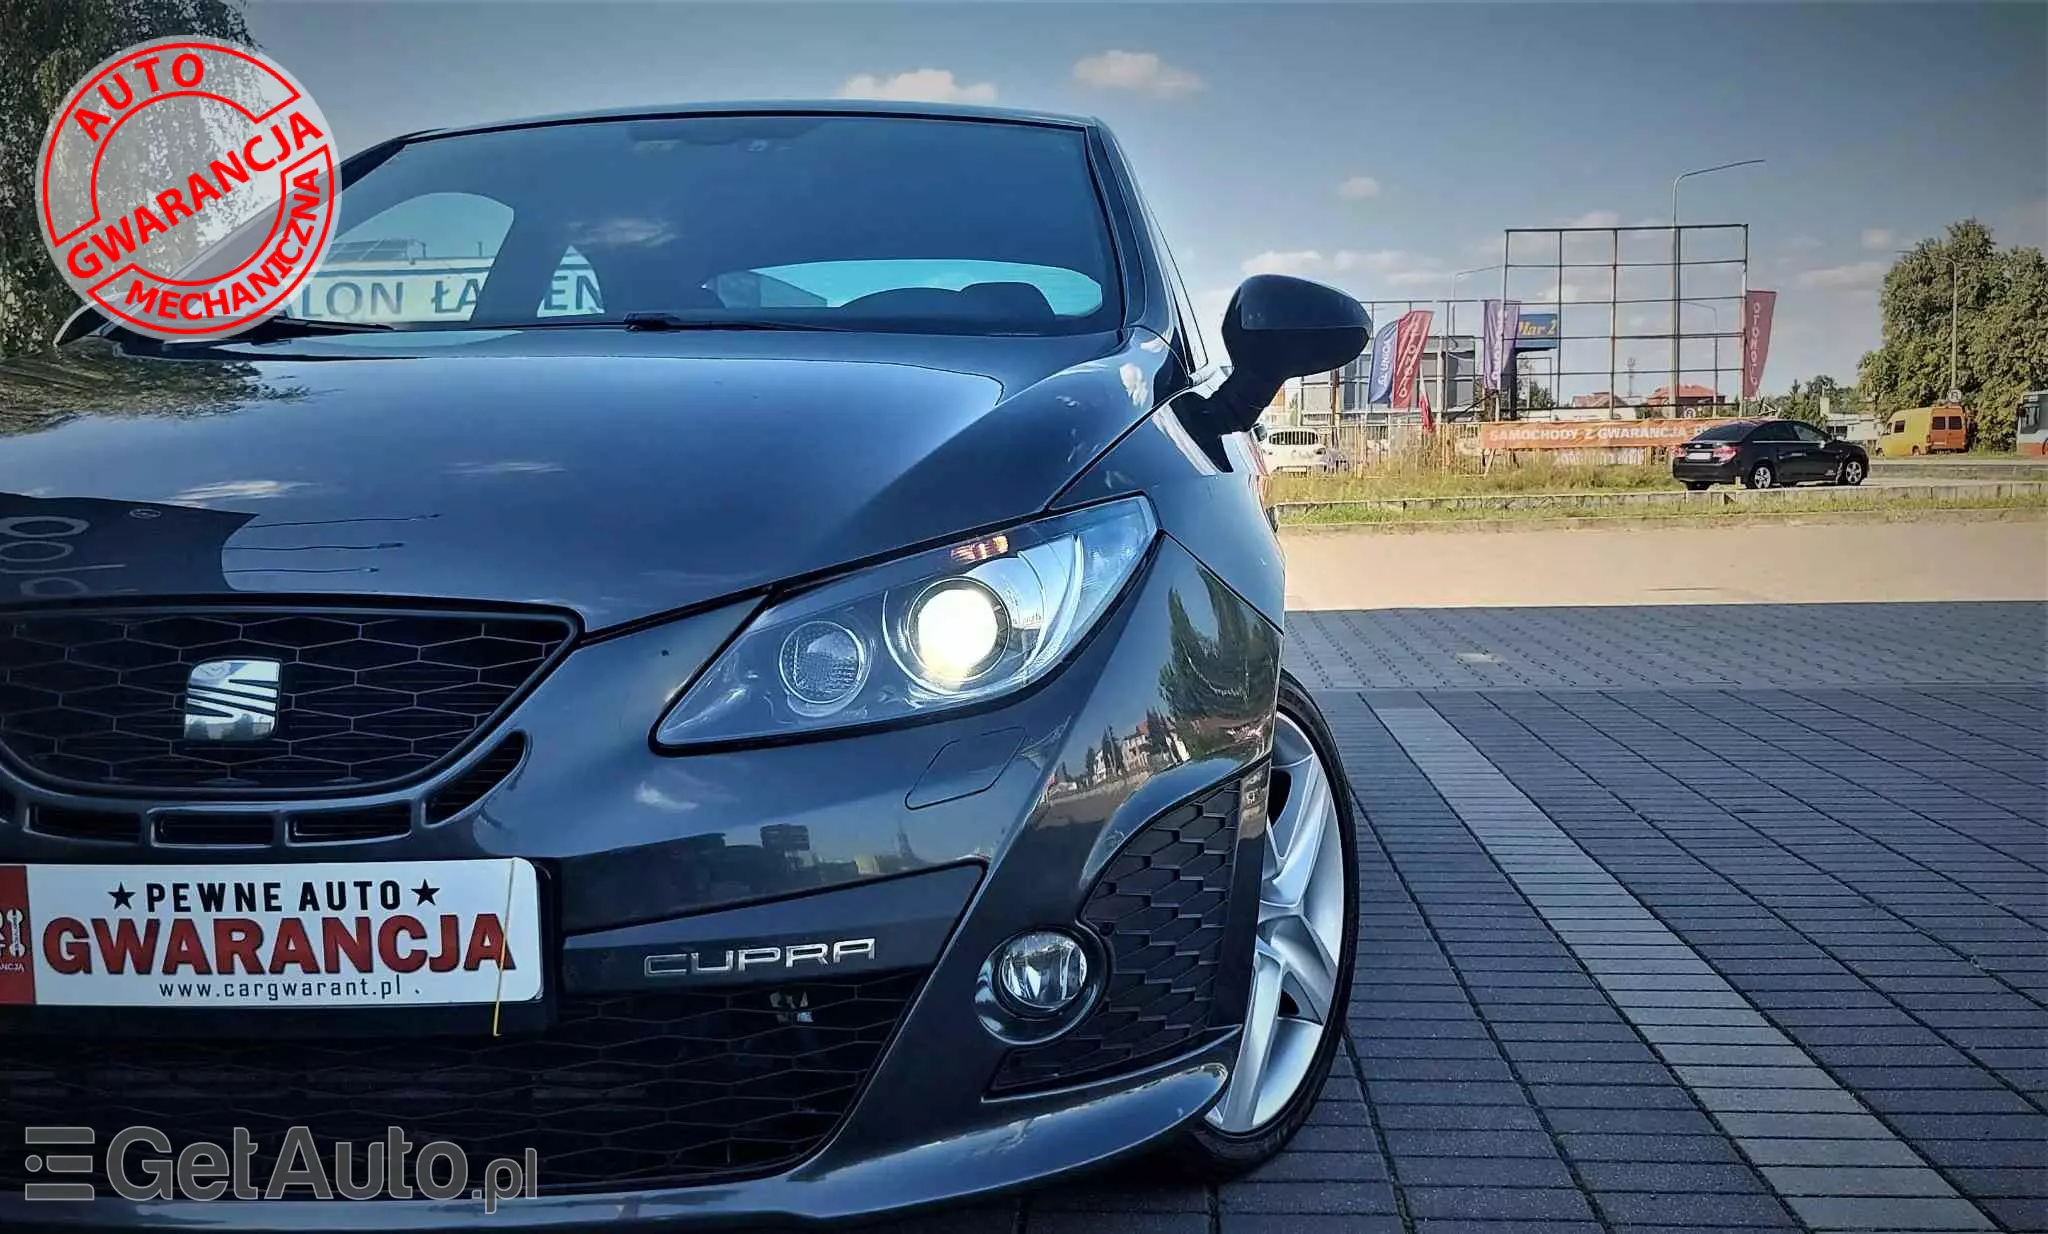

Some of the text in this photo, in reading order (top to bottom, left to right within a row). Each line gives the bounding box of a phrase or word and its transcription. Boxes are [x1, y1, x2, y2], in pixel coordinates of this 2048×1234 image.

[1490, 428, 1577, 442] SAMOCHODY
[147, 880, 401, 912] PEWNE AUTO
[43, 914, 516, 975] GWARANCJA
[645, 938, 876, 977] CUPRA
[159, 976, 402, 1001] www.cargwarant.pl
